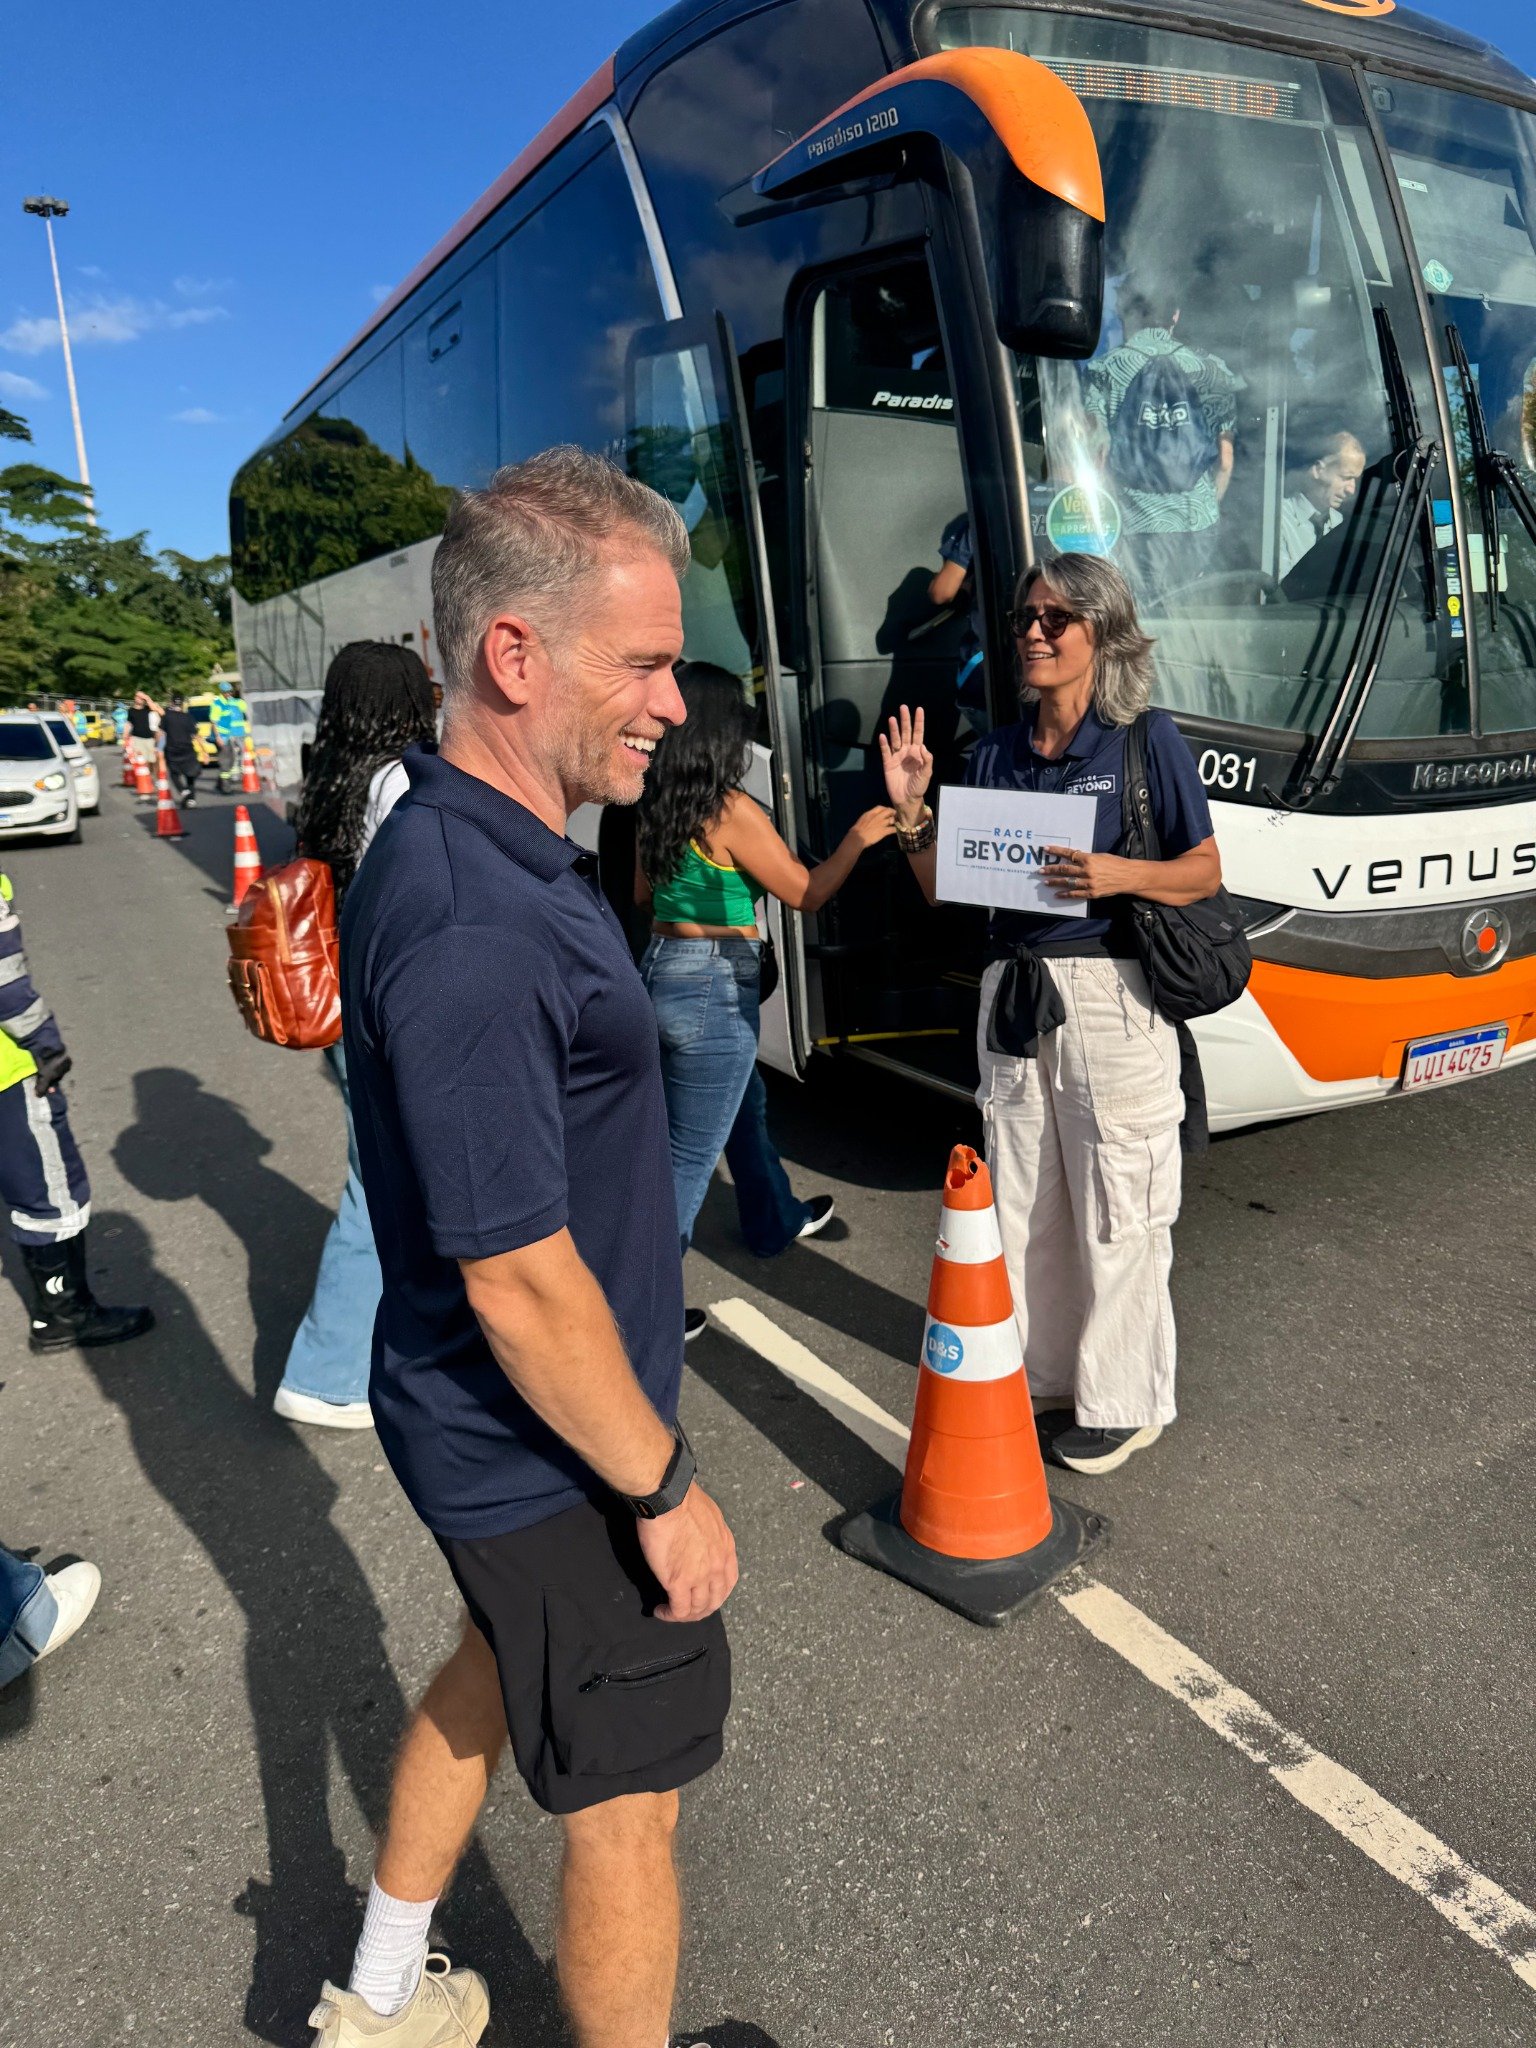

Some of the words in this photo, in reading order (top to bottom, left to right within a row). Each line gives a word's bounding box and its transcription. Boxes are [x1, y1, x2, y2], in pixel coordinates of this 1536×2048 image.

[808, 123, 863, 159] Paradiso
[866, 107, 899, 134] 1200
[1067, 780, 1112, 794] BEYOND
[1198, 749, 1257, 792] 031
[1411, 754, 1536, 790] Marcopol
[994, 828, 1032, 839] RACE
[1312, 842, 1536, 900] venus
[1412, 1044, 1494, 1084] LUI4C75
[929, 1337, 959, 1360] D&S
